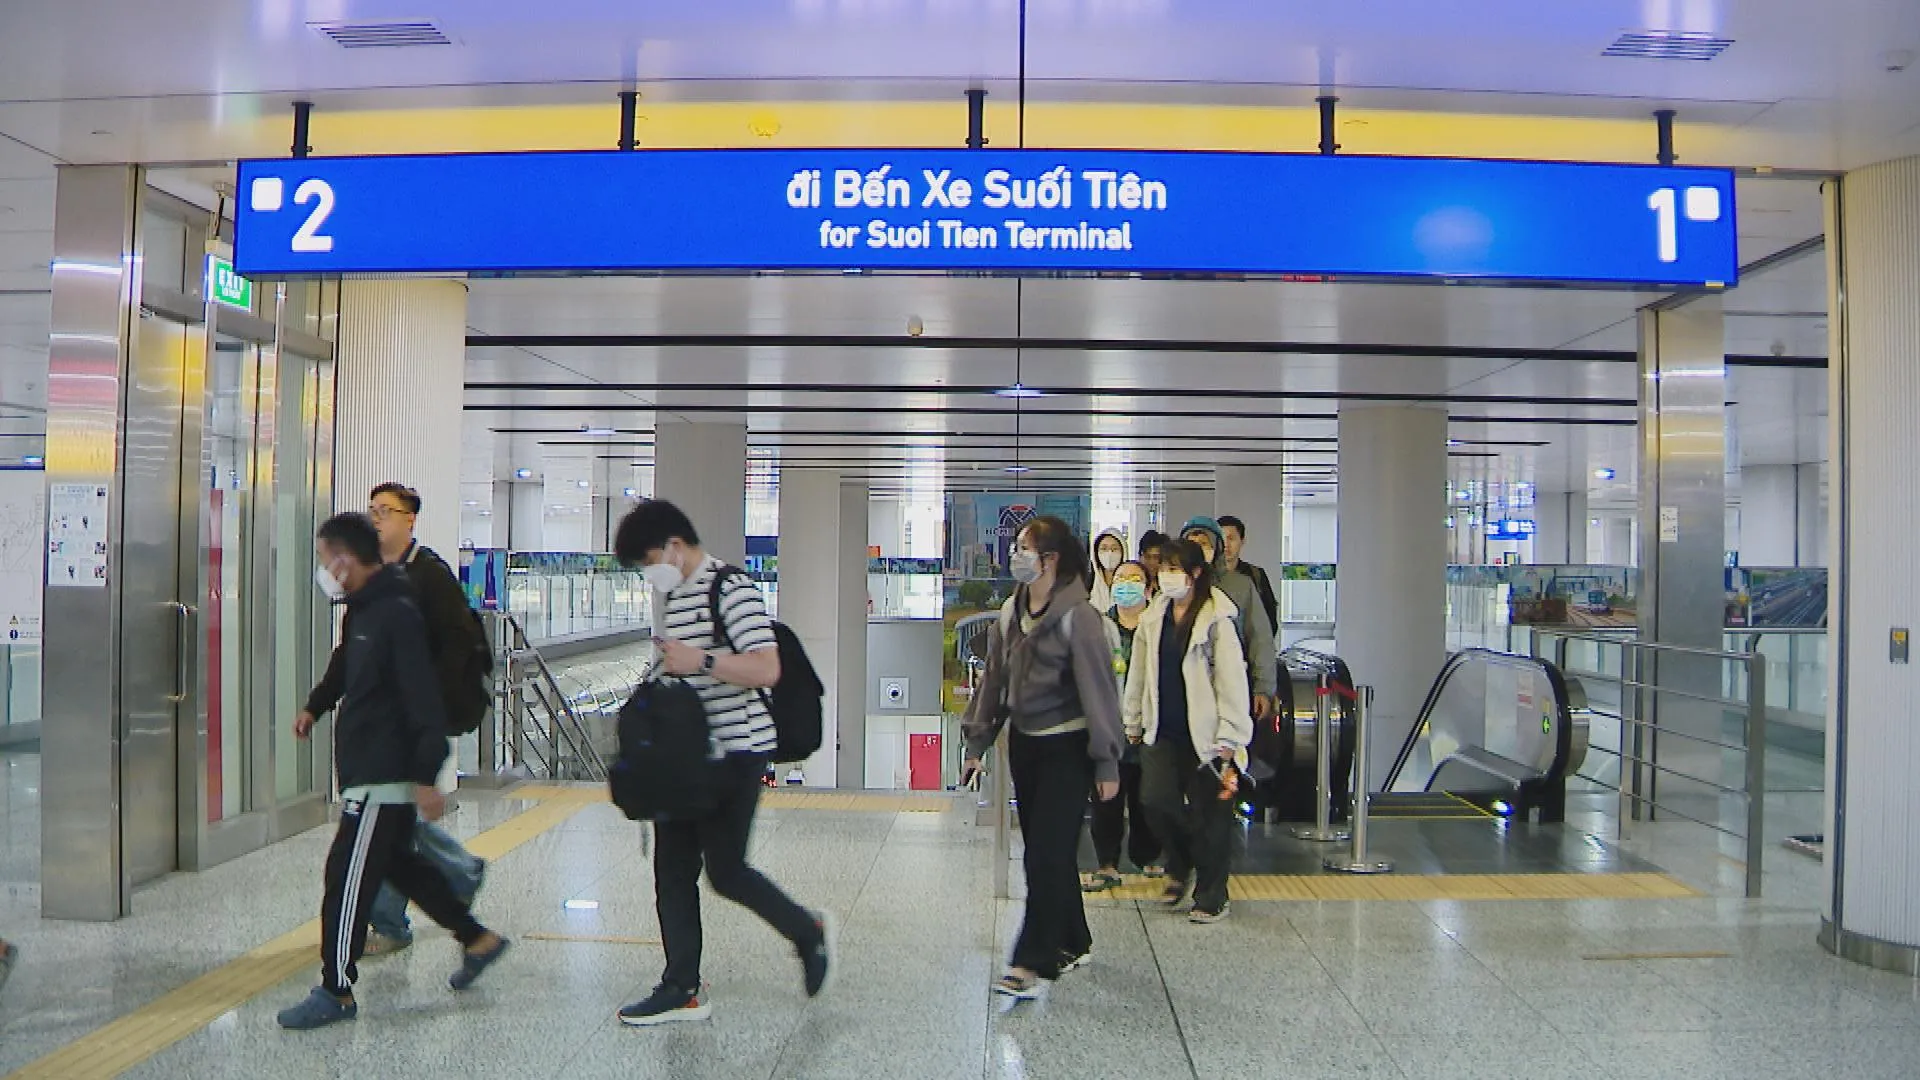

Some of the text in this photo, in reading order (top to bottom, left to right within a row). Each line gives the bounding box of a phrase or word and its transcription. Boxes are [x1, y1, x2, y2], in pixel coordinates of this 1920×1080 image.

[291, 178, 335, 252] 2
[786, 164, 1167, 209] đi Bến Xe Suối Tiên
[819, 219, 1132, 250] for Suoi Tien Terminal
[1648, 188, 1676, 262] 1
